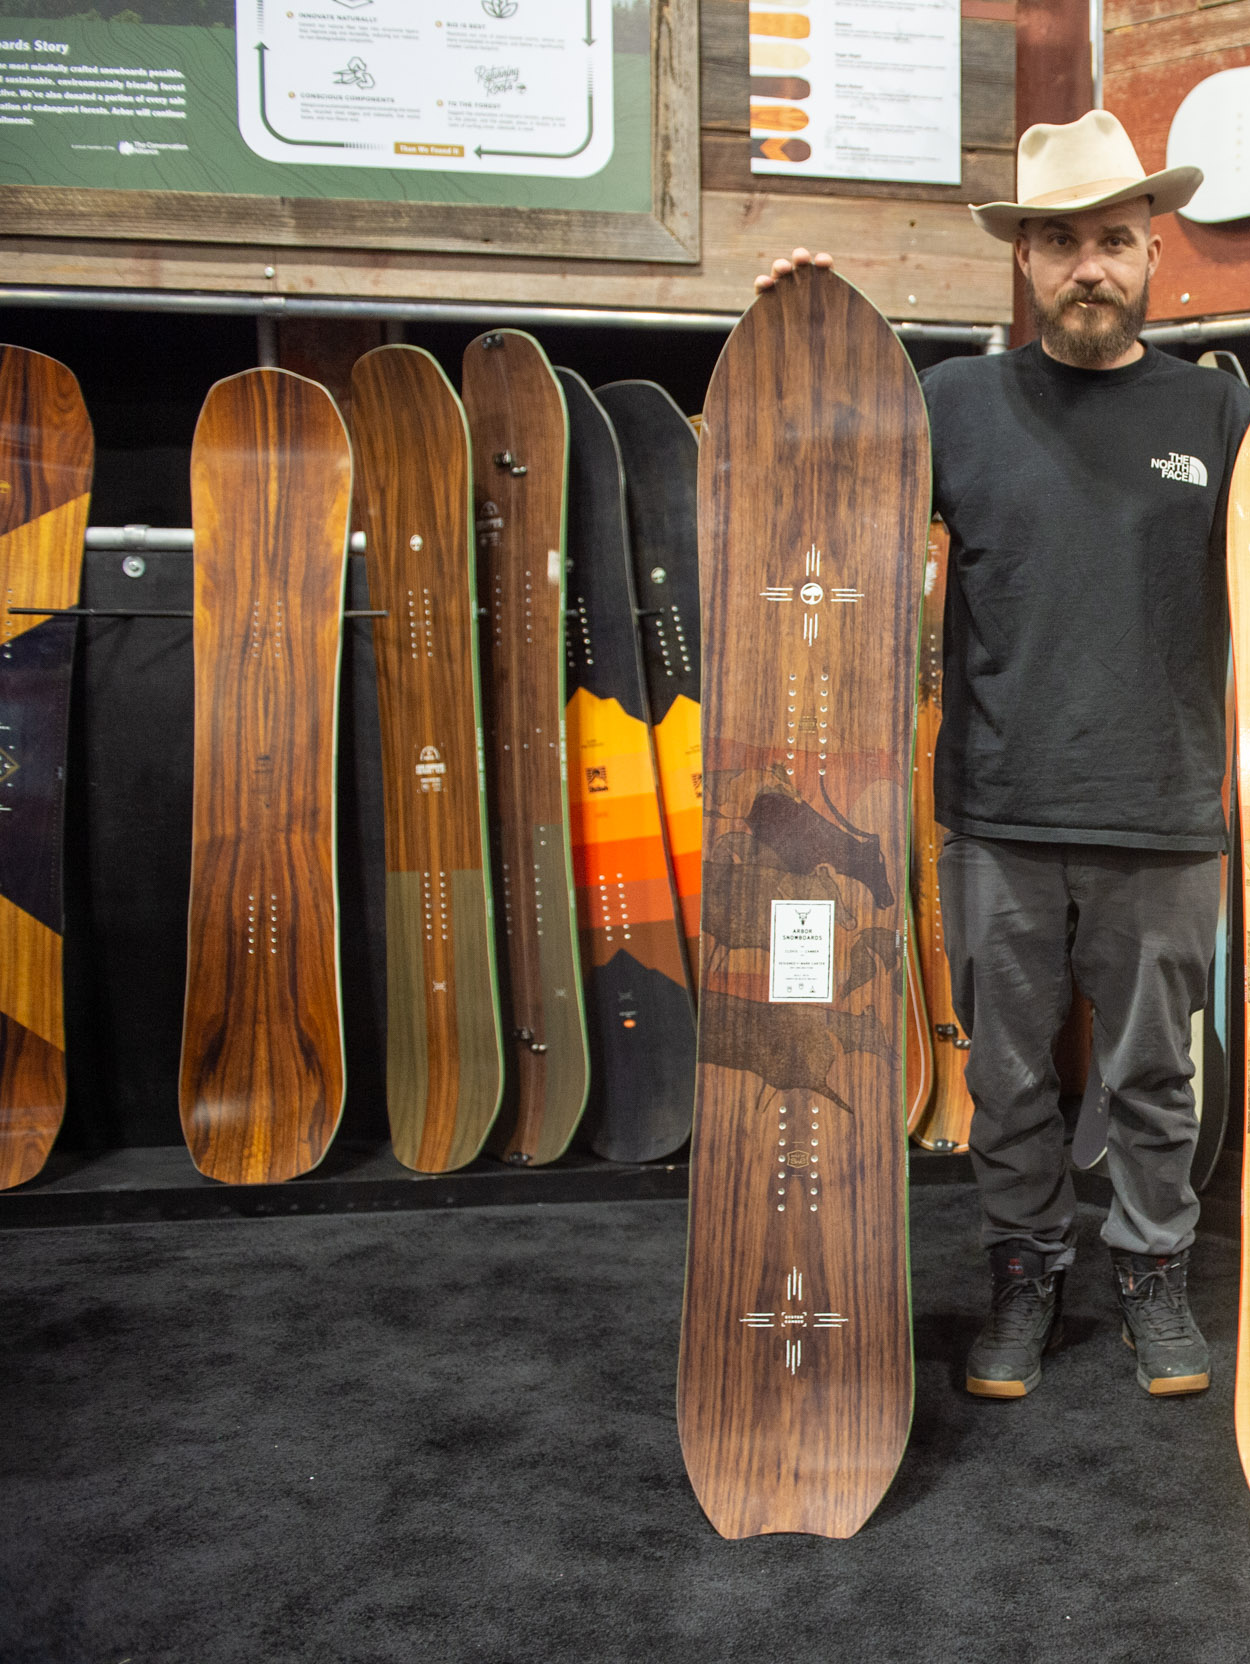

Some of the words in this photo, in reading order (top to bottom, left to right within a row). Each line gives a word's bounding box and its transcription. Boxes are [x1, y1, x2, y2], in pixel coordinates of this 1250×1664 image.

[33, 39, 69, 55] Story
[69, 65, 99, 74] crafted
[100, 67, 148, 76] snowboards
[1168, 452, 1190, 464] THE
[1151, 458, 1190, 473] NORTH
[1161, 469, 1190, 482] FACE
